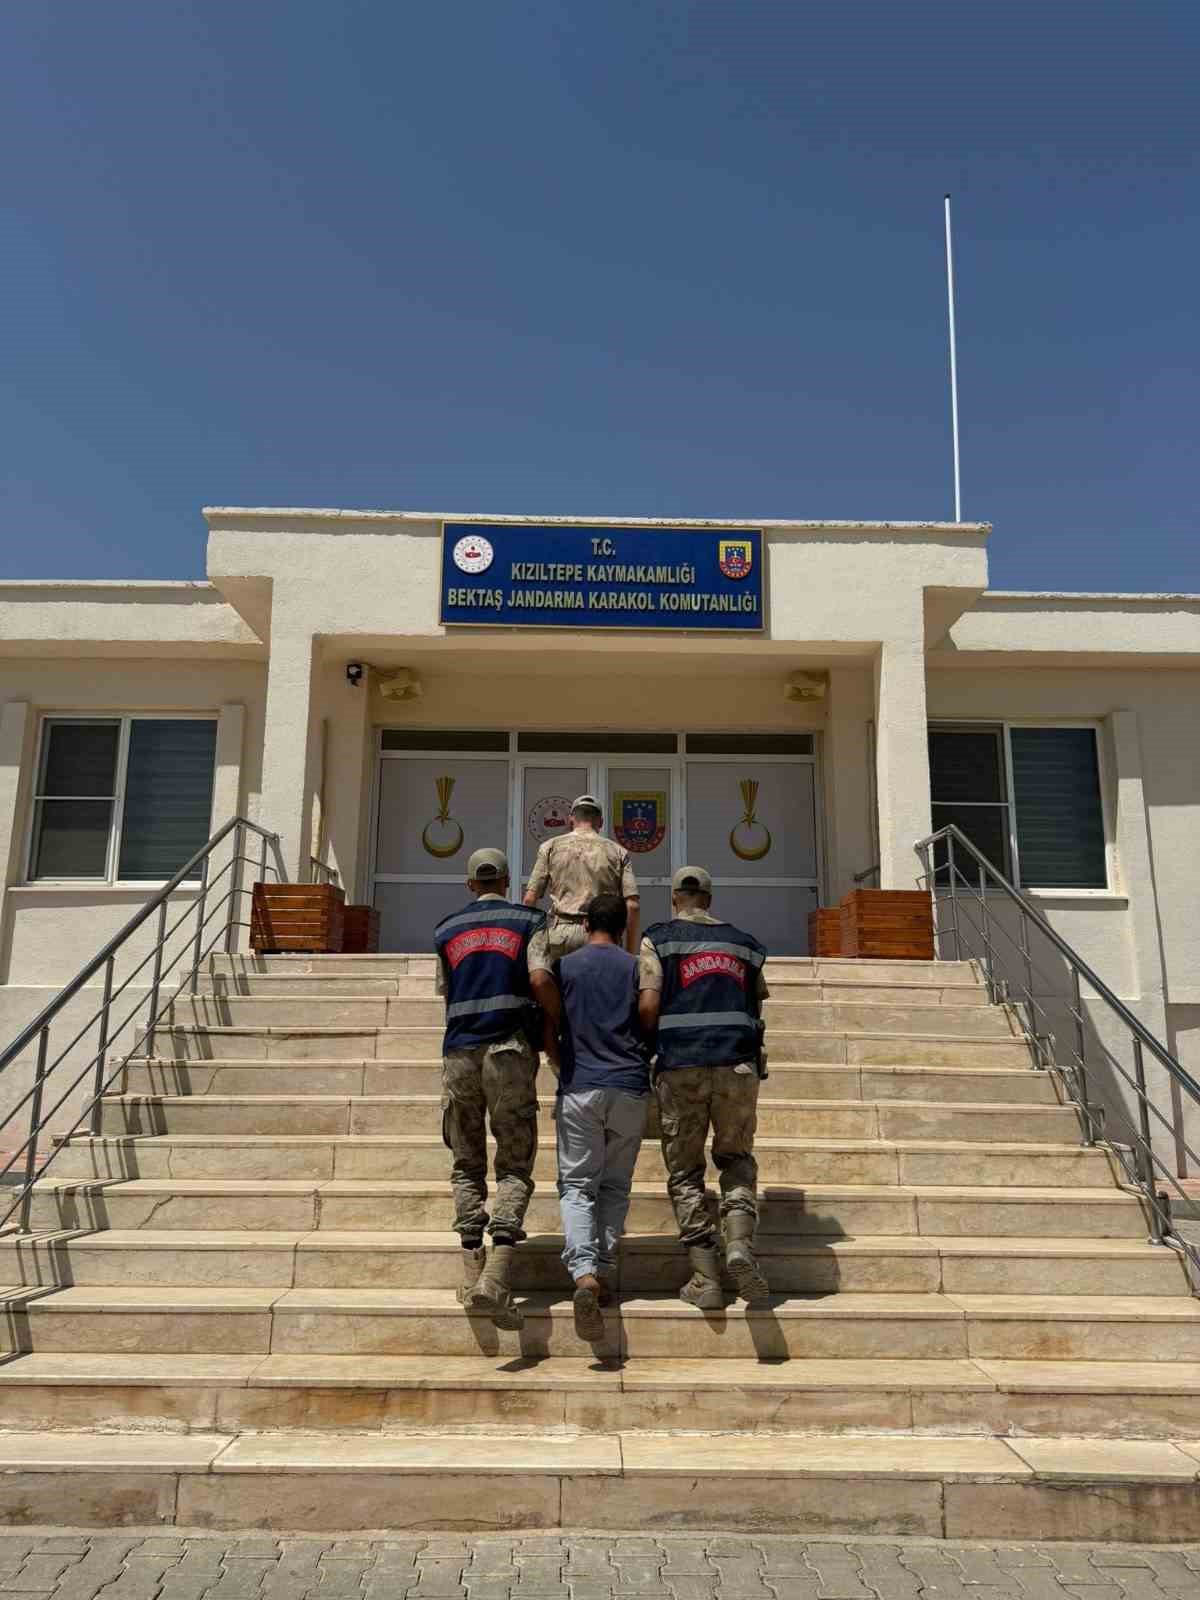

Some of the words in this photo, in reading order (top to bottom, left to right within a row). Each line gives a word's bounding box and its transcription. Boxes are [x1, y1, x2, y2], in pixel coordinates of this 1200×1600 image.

[591, 538, 616, 555] T.C.
[511, 562, 583, 581] KIZILTEPE
[587, 562, 696, 584] KAYMAKAMLIĞI
[447, 588, 503, 611] BEKTAŞ
[507, 590, 585, 609] JANDARMA
[589, 591, 655, 610] KARAKOL
[660, 591, 757, 612] KOMUTANLIĞI
